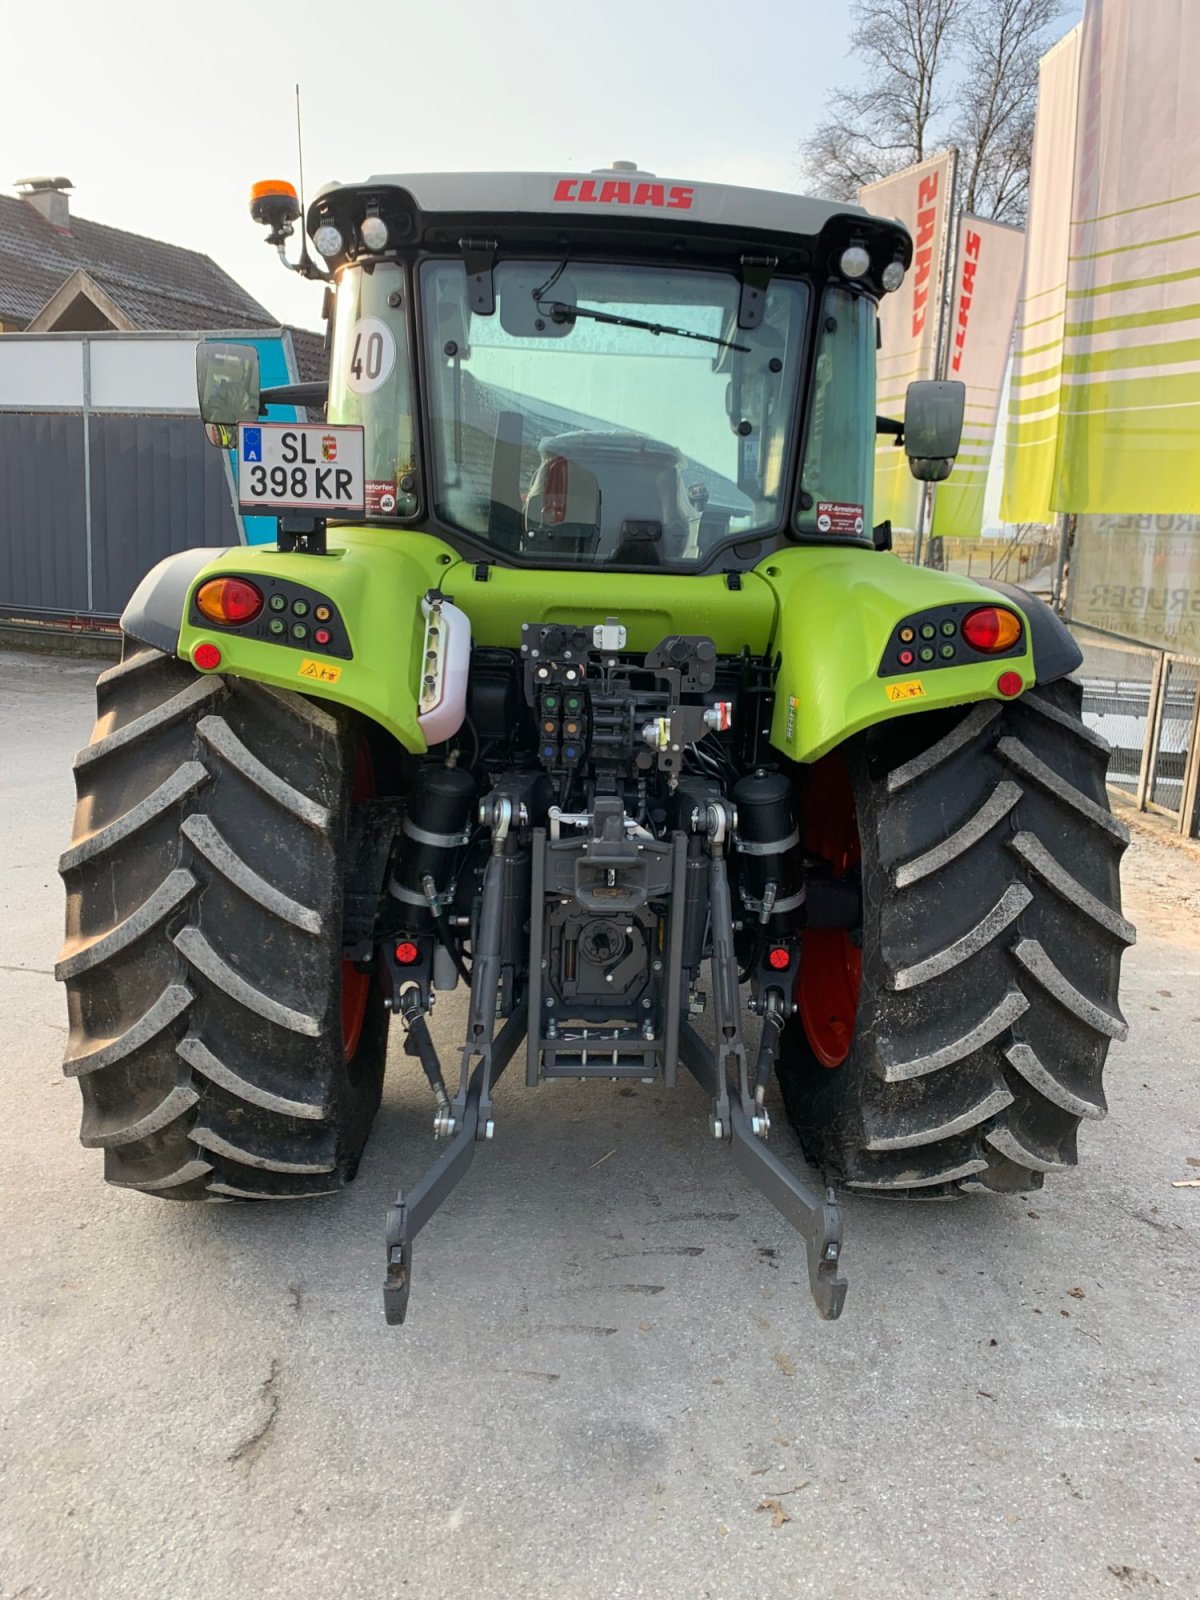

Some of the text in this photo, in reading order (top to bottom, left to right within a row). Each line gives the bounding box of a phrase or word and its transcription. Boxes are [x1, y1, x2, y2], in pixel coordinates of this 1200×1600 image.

[553, 179, 694, 209] CLAAS
[952, 229, 981, 372] CLAAS
[350, 332, 383, 380] 40
[248, 450, 257, 460] A
[281, 432, 316, 464] SL
